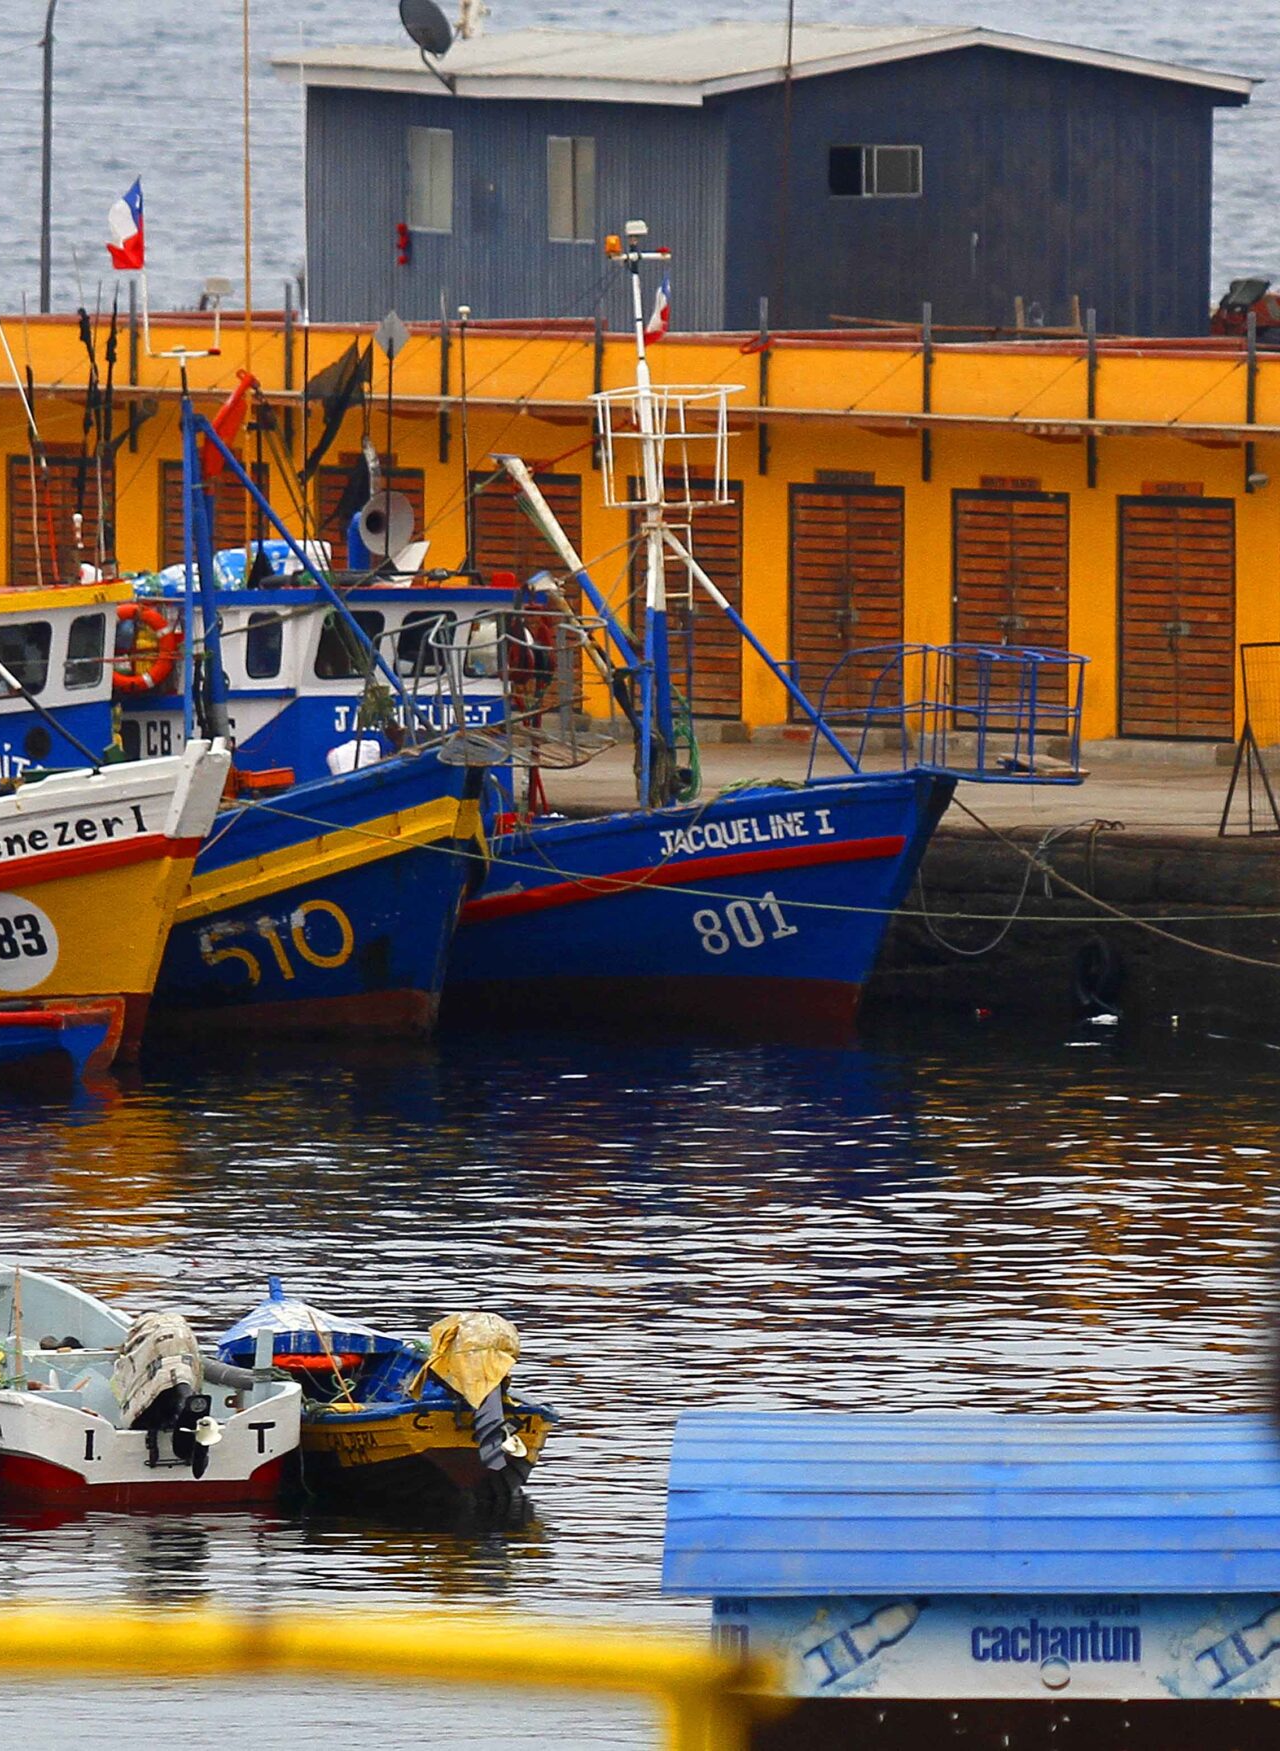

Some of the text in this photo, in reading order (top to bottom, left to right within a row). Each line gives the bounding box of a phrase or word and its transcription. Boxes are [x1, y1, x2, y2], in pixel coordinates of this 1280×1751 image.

[133, 804, 149, 833] I
[659, 809, 835, 857] JACQUELINE I
[200, 898, 355, 987] 510
[692, 890, 798, 955] 801
[971, 1618, 1142, 1663] cachantun
